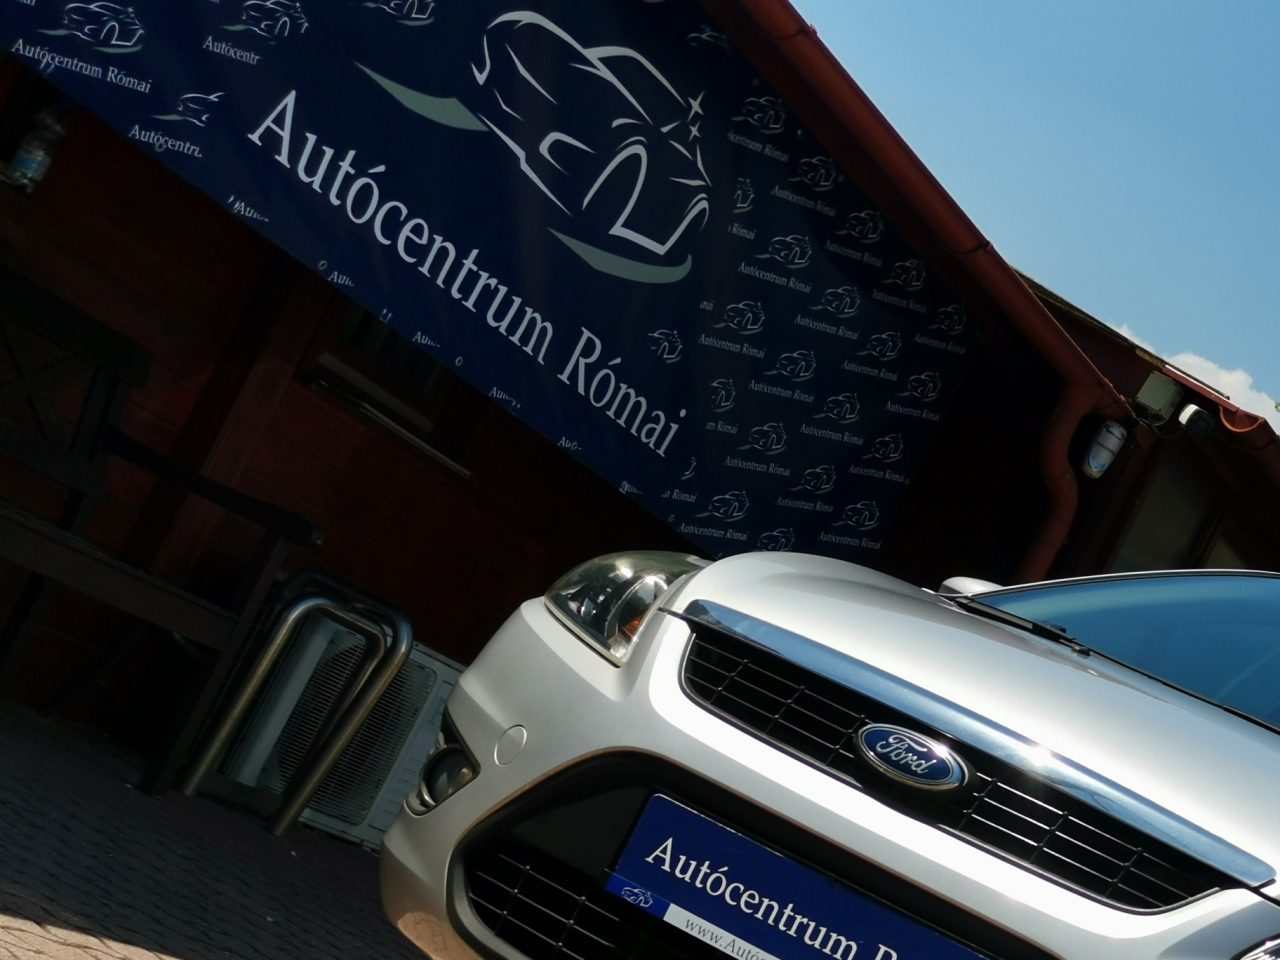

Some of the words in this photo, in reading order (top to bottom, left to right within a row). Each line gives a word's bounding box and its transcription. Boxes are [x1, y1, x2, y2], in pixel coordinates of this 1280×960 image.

[11, 38, 103, 79] Autócentrum
[107, 66, 152, 94] Római
[246, 89, 556, 365] Autócentrum
[556, 326, 688, 458] Római
[876, 734, 937, 774] Ford
